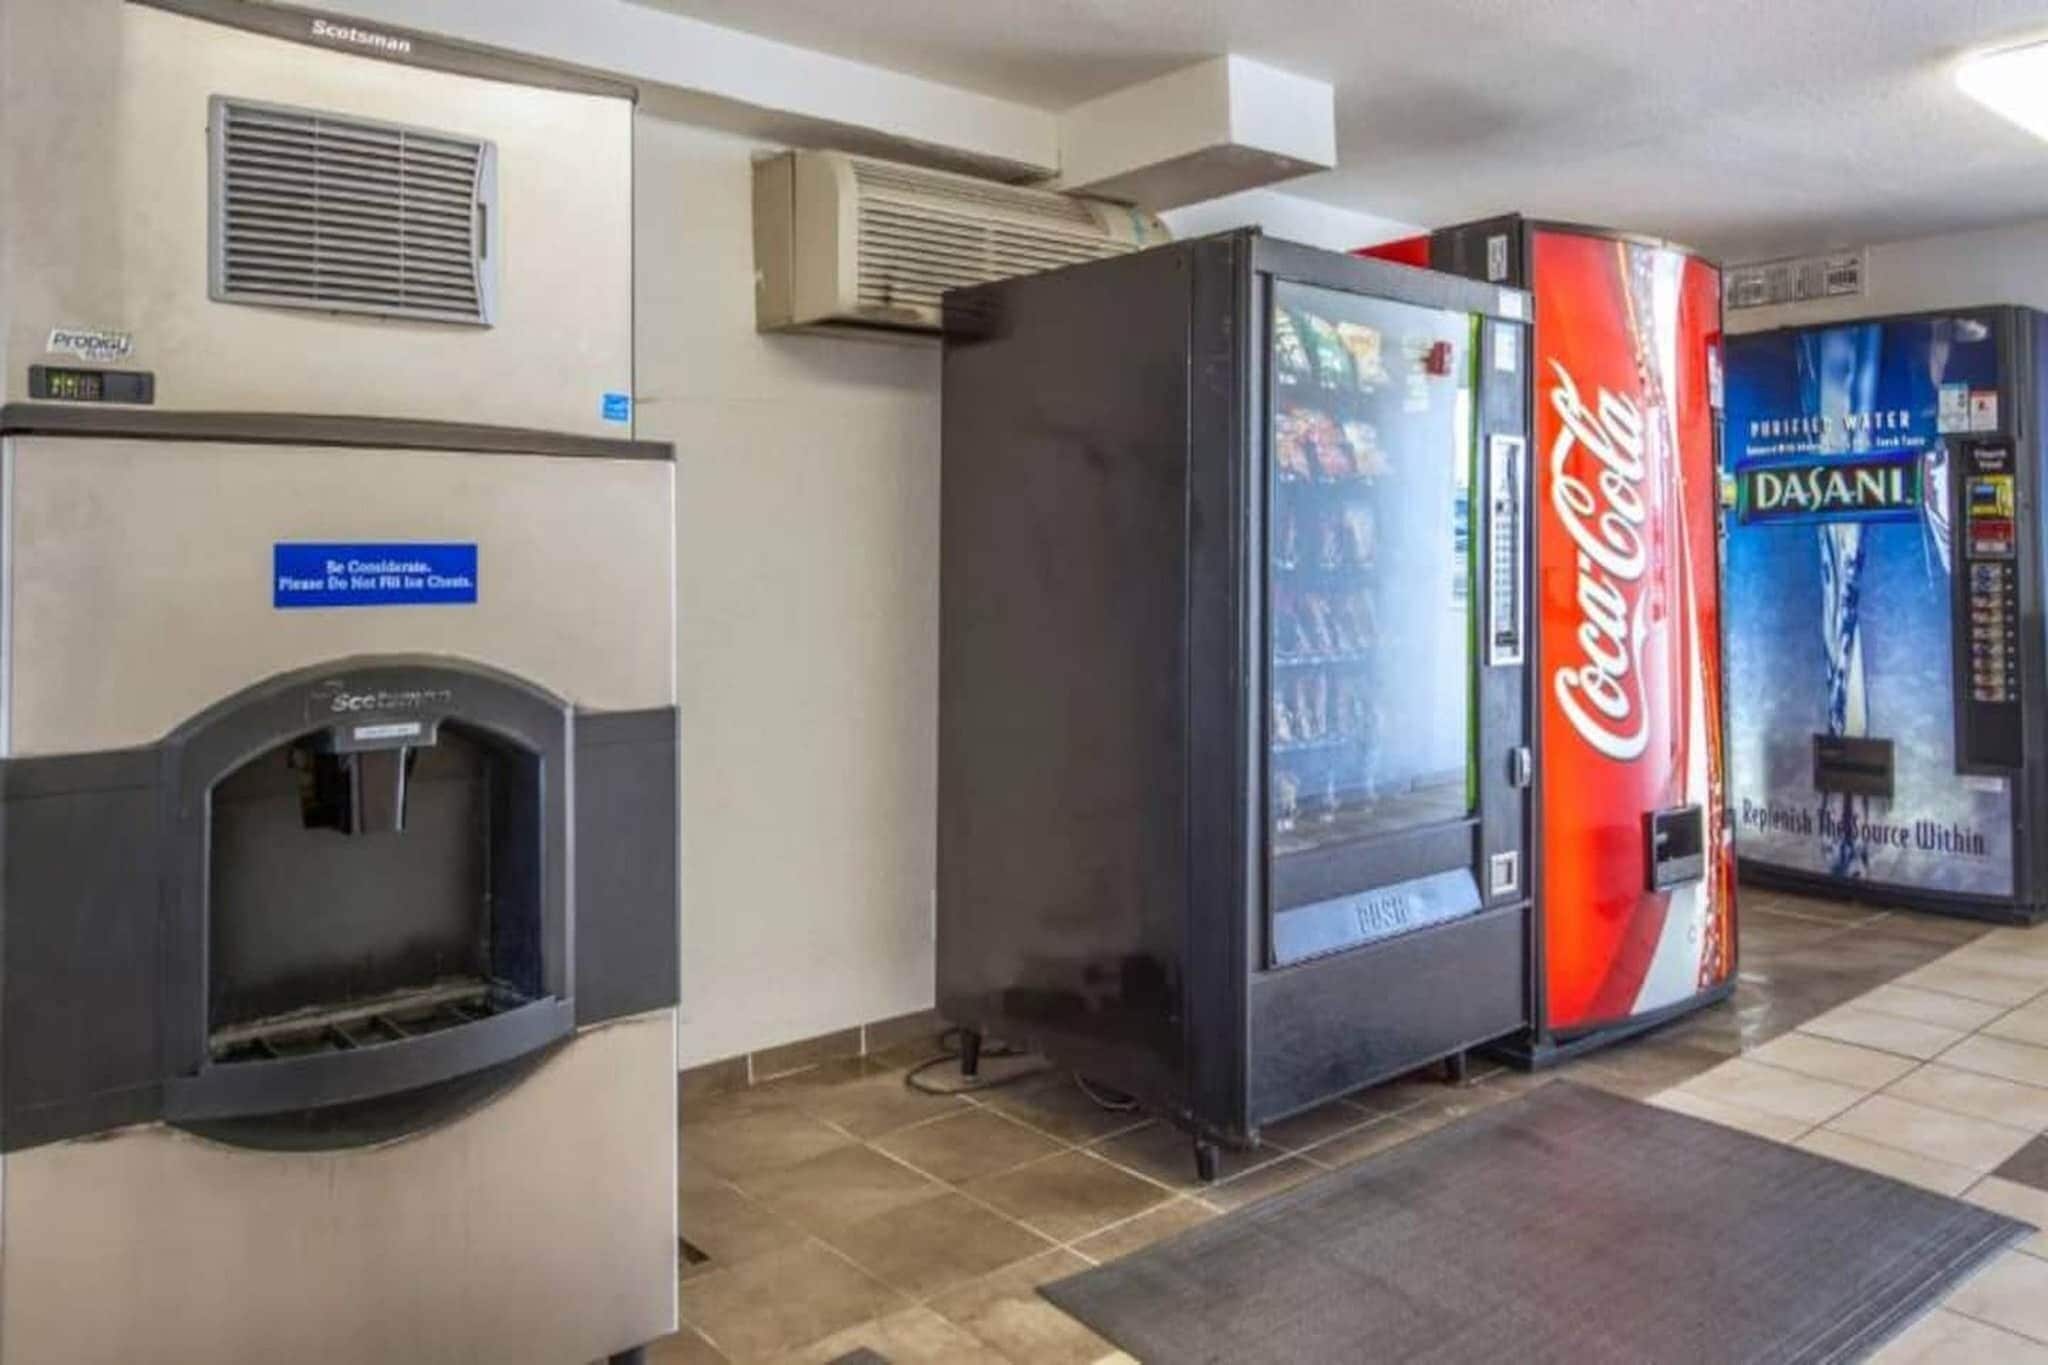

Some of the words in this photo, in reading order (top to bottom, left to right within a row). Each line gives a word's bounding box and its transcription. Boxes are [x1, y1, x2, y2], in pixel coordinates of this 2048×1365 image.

[312, 19, 411, 51] Scotsman
[1751, 417, 1833, 437] PURIFIED
[1844, 410, 1910, 430] WATER
[1756, 467, 1903, 511] DASANI
[326, 560, 345, 574] Be
[348, 560, 432, 574] Considerate.
[279, 577, 324, 591] Please
[328, 576, 348, 590] Do
[351, 576, 376, 590] Not
[380, 575, 400, 589] Fill
[405, 575, 424, 589] Ice
[427, 575, 473, 589] Chests.
[1743, 799, 1812, 835] Replenish
[1818, 811, 1844, 840] The
[1852, 815, 1909, 848] Source
[1916, 820, 1985, 856] Within
